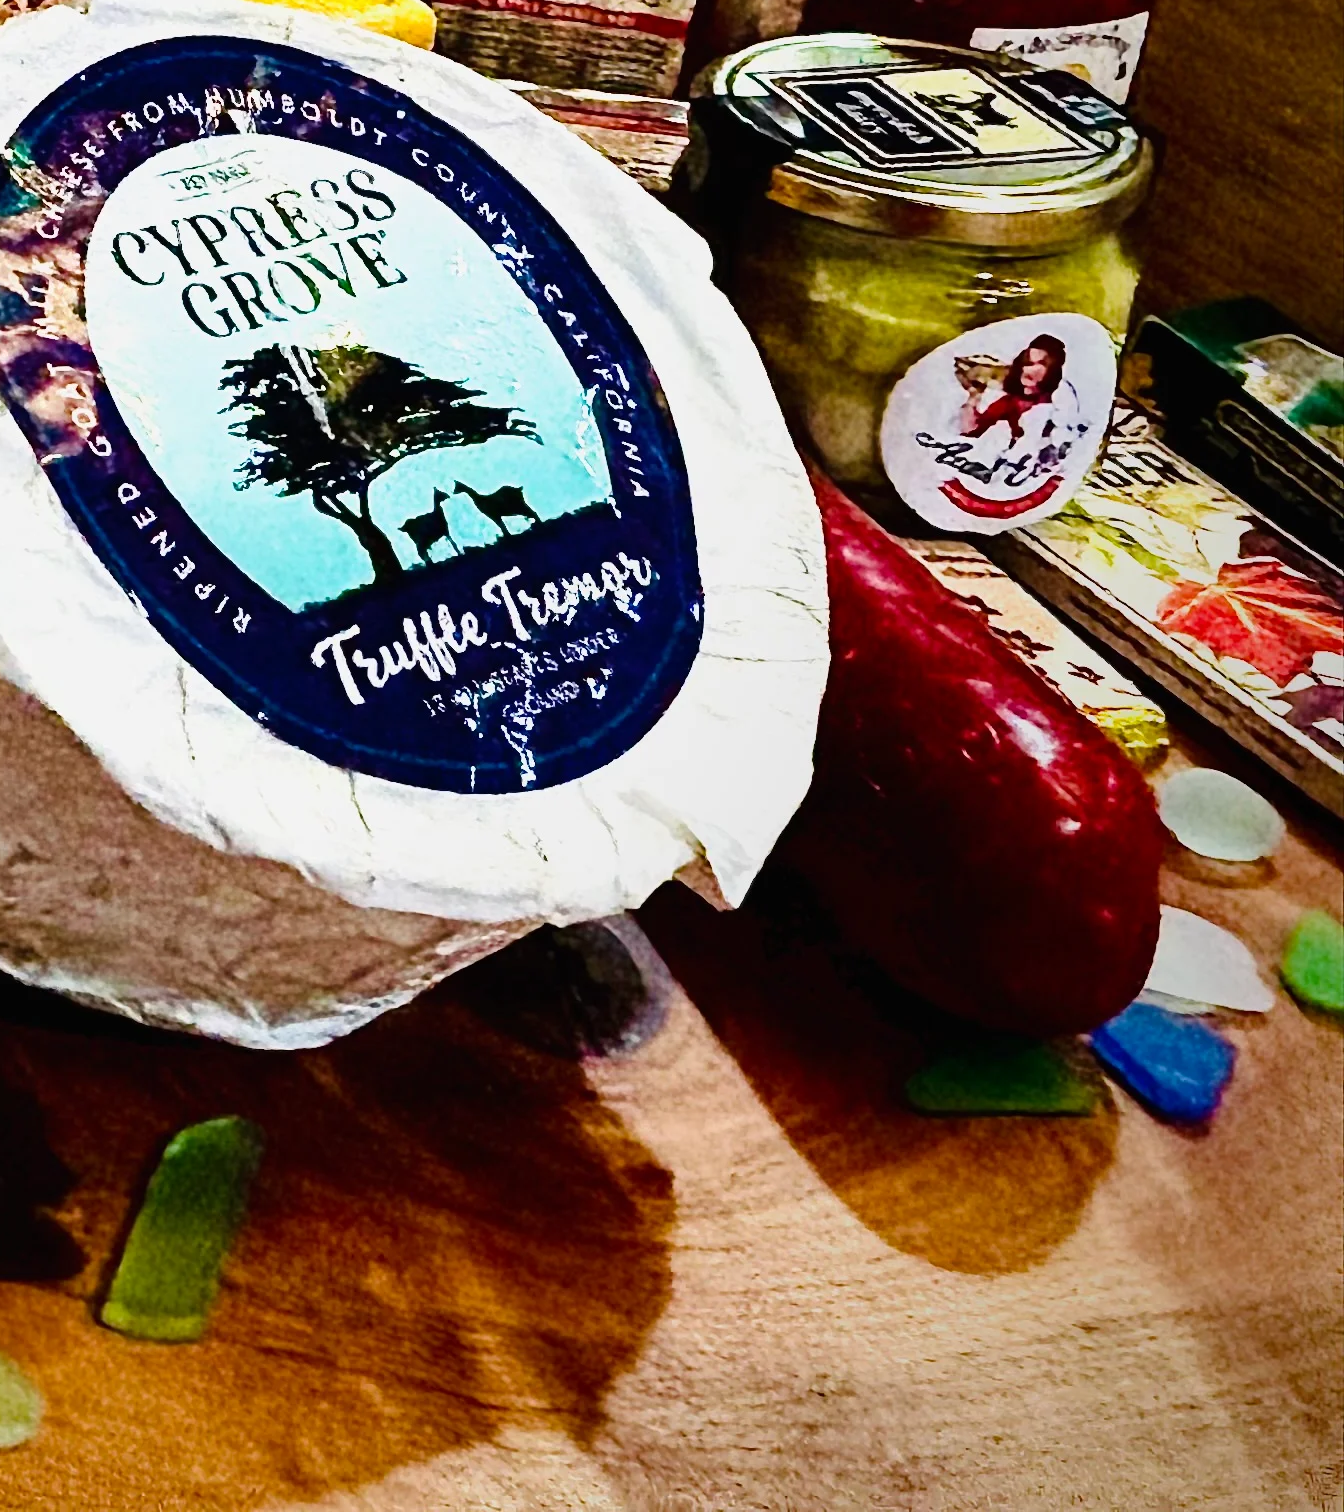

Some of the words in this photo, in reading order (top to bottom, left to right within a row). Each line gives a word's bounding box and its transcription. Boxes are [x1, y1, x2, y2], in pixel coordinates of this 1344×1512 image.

[108, 91, 194, 142] FROM
[205, 87, 388, 146] HUMBOLDT
[36, 138, 106, 239] CHEESE
[111, 169, 396, 285] CYPRESS
[182, 229, 408, 338] GROVE
[48, 364, 112, 458] GOAT
[544, 284, 650, 498] CALIFORNIA
[118, 482, 251, 634] RIPENED
[311, 603, 488, 707] Truffle
[482, 551, 660, 641] Tremor
